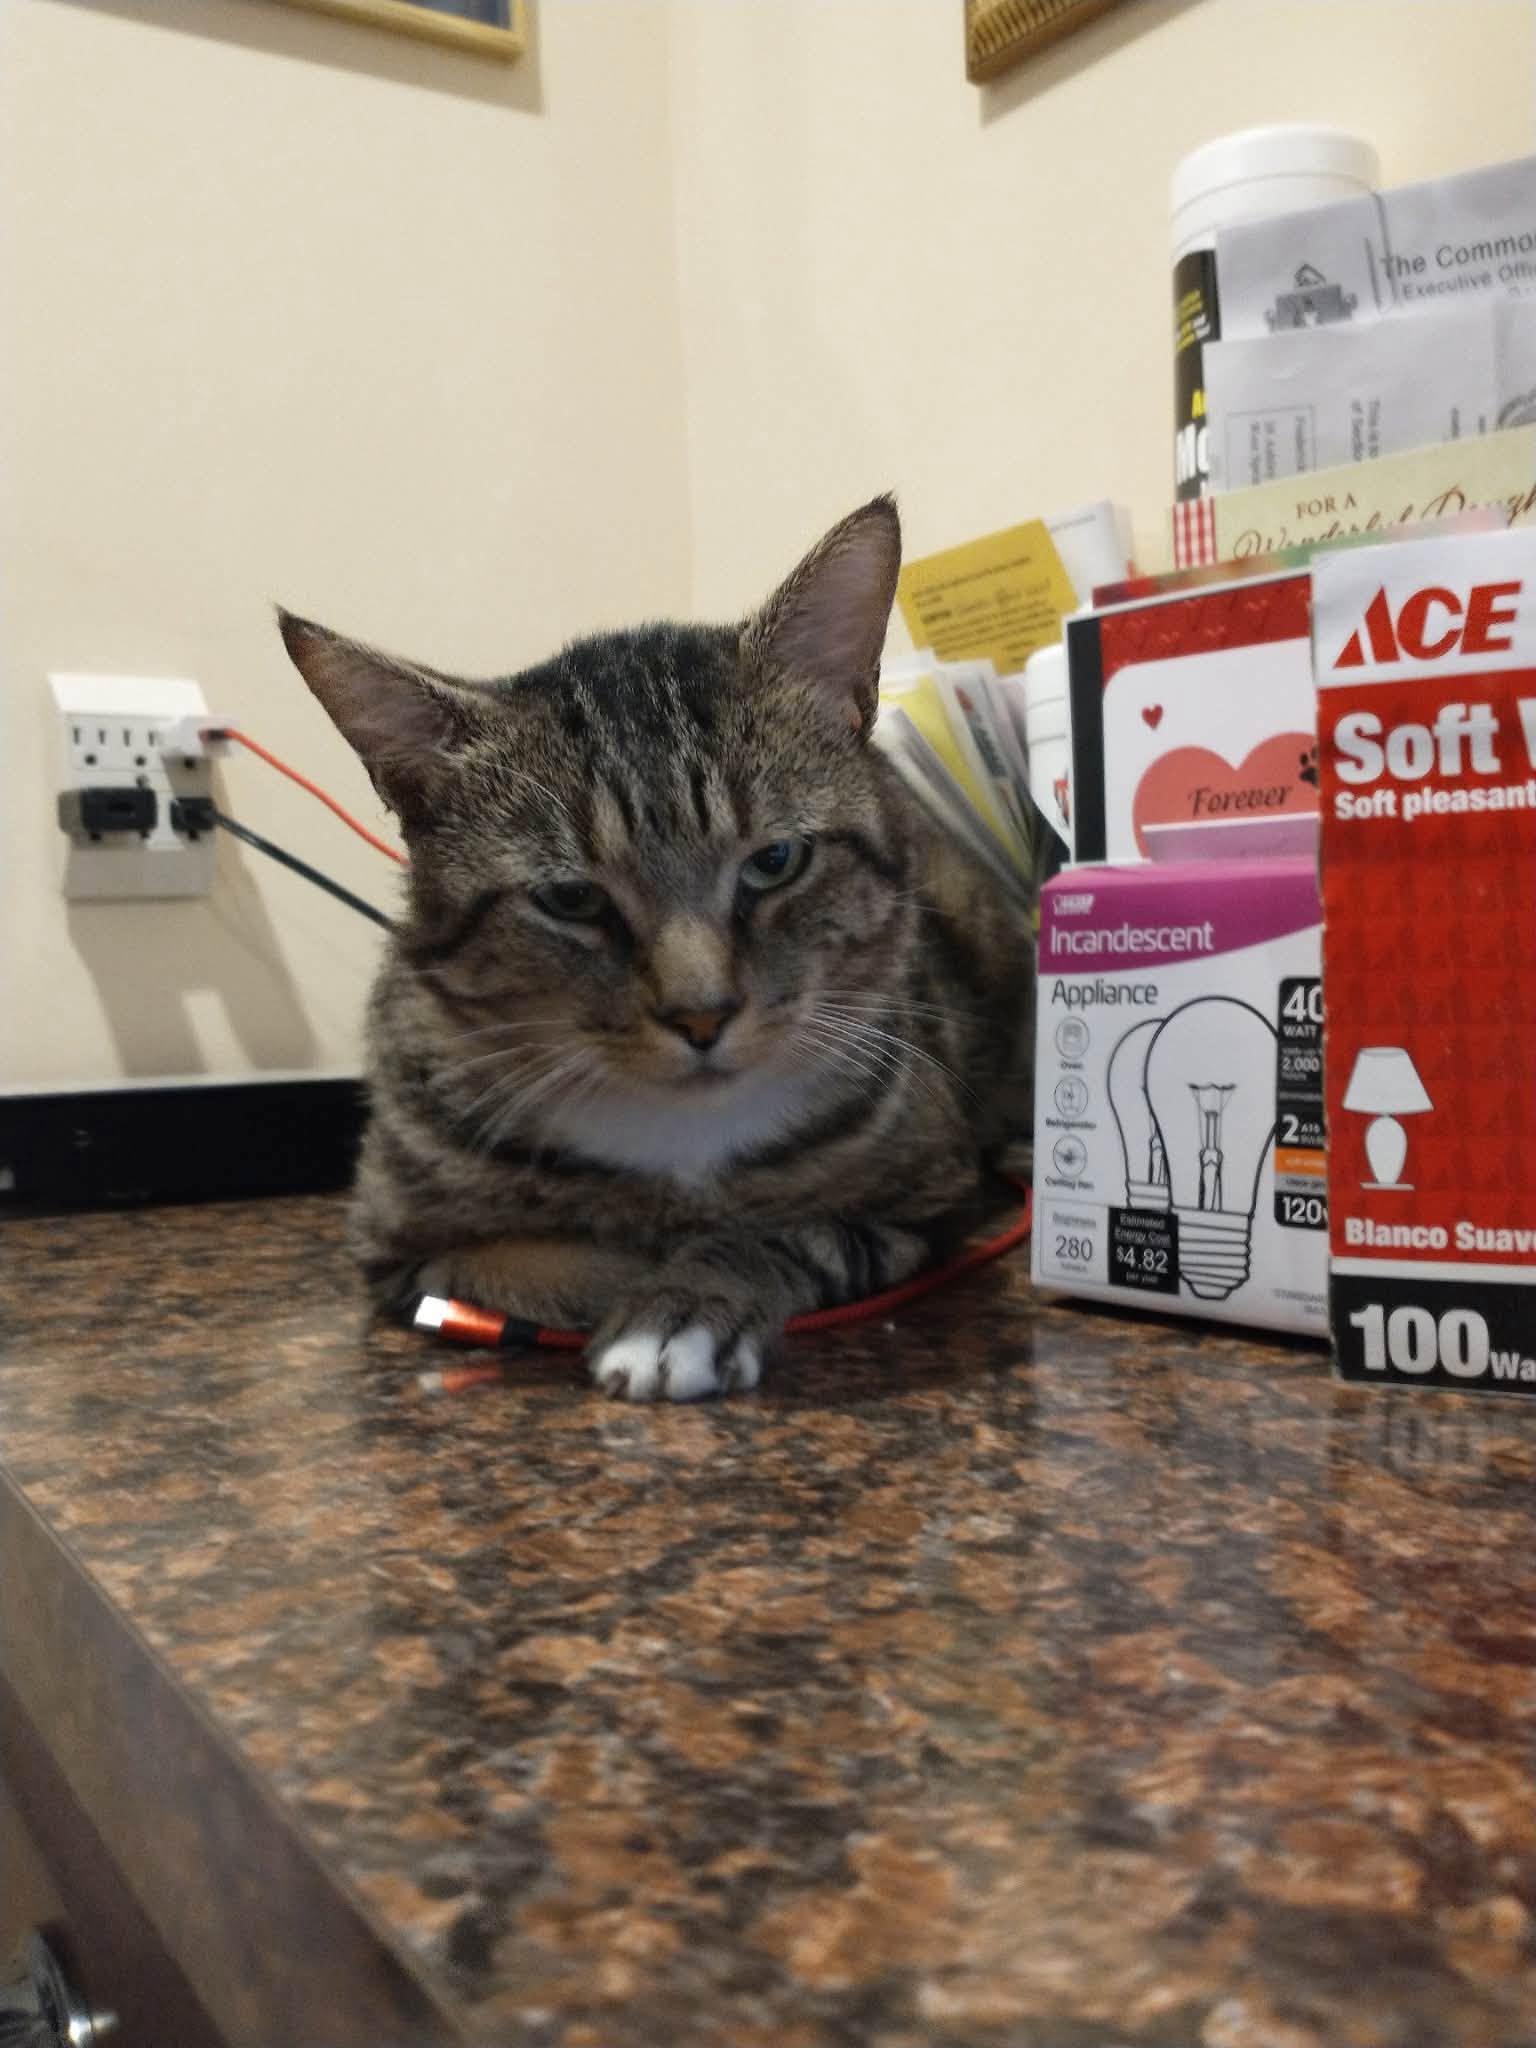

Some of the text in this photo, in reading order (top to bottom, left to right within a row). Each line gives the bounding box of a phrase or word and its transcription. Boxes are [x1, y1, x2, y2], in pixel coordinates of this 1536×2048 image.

[1380, 232, 1536, 279] The Commo
[1402, 271, 1491, 298] Executive
[1498, 261, 1536, 284] Offi
[1296, 492, 1358, 520] FOR A
[1232, 503, 1413, 560] Wnderfl
[1333, 580, 1522, 669] ACE
[1334, 702, 1501, 784] Soft
[1187, 784, 1294, 817] Forever
[1335, 788, 1397, 821] Soft
[1050, 921, 1214, 955] Incandescent
[1052, 978, 1158, 1011] Appliance
[1283, 984, 1324, 1024] 40
[1283, 1025, 1318, 1038] WATT
[1280, 1114, 1299, 1143] 2
[1055, 1235, 1093, 1261] 280
[1345, 1217, 1448, 1250] Blanco
[1116, 1245, 1168, 1274] $4.82
[1349, 1304, 1536, 1382] 100 Wa
